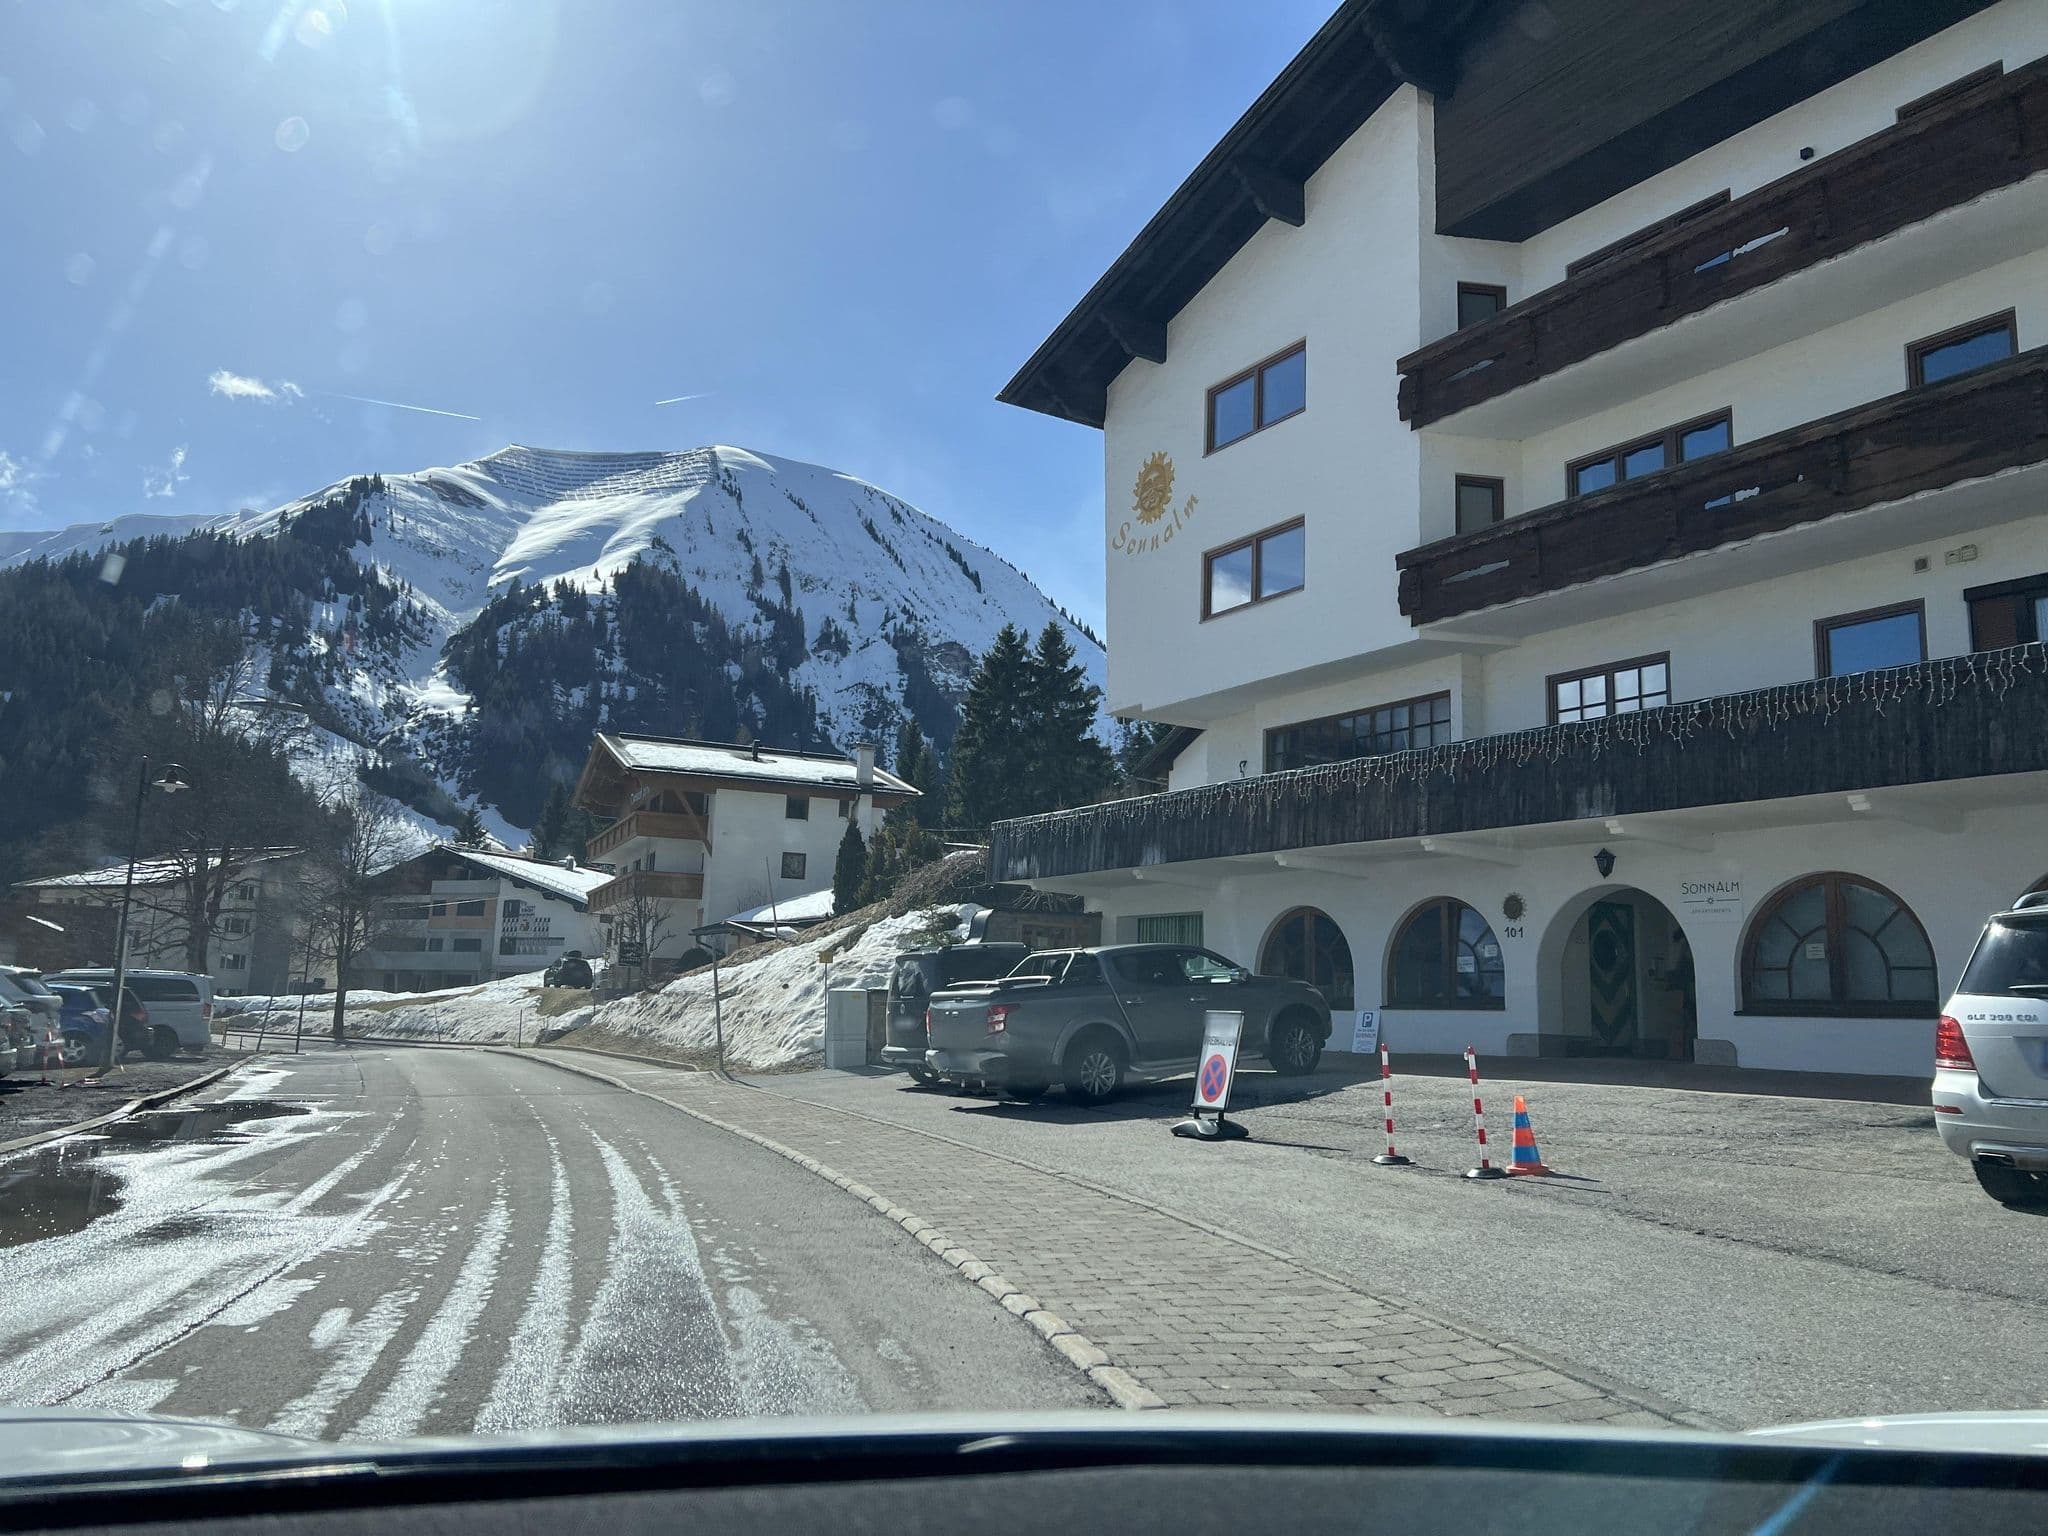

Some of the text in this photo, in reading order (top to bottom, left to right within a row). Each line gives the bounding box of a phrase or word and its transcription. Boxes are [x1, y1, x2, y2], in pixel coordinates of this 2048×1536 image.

[1111, 494, 1199, 554] Sonnalm
[1681, 881, 1740, 895] SONNALM
[1504, 926, 1524, 938] 101
